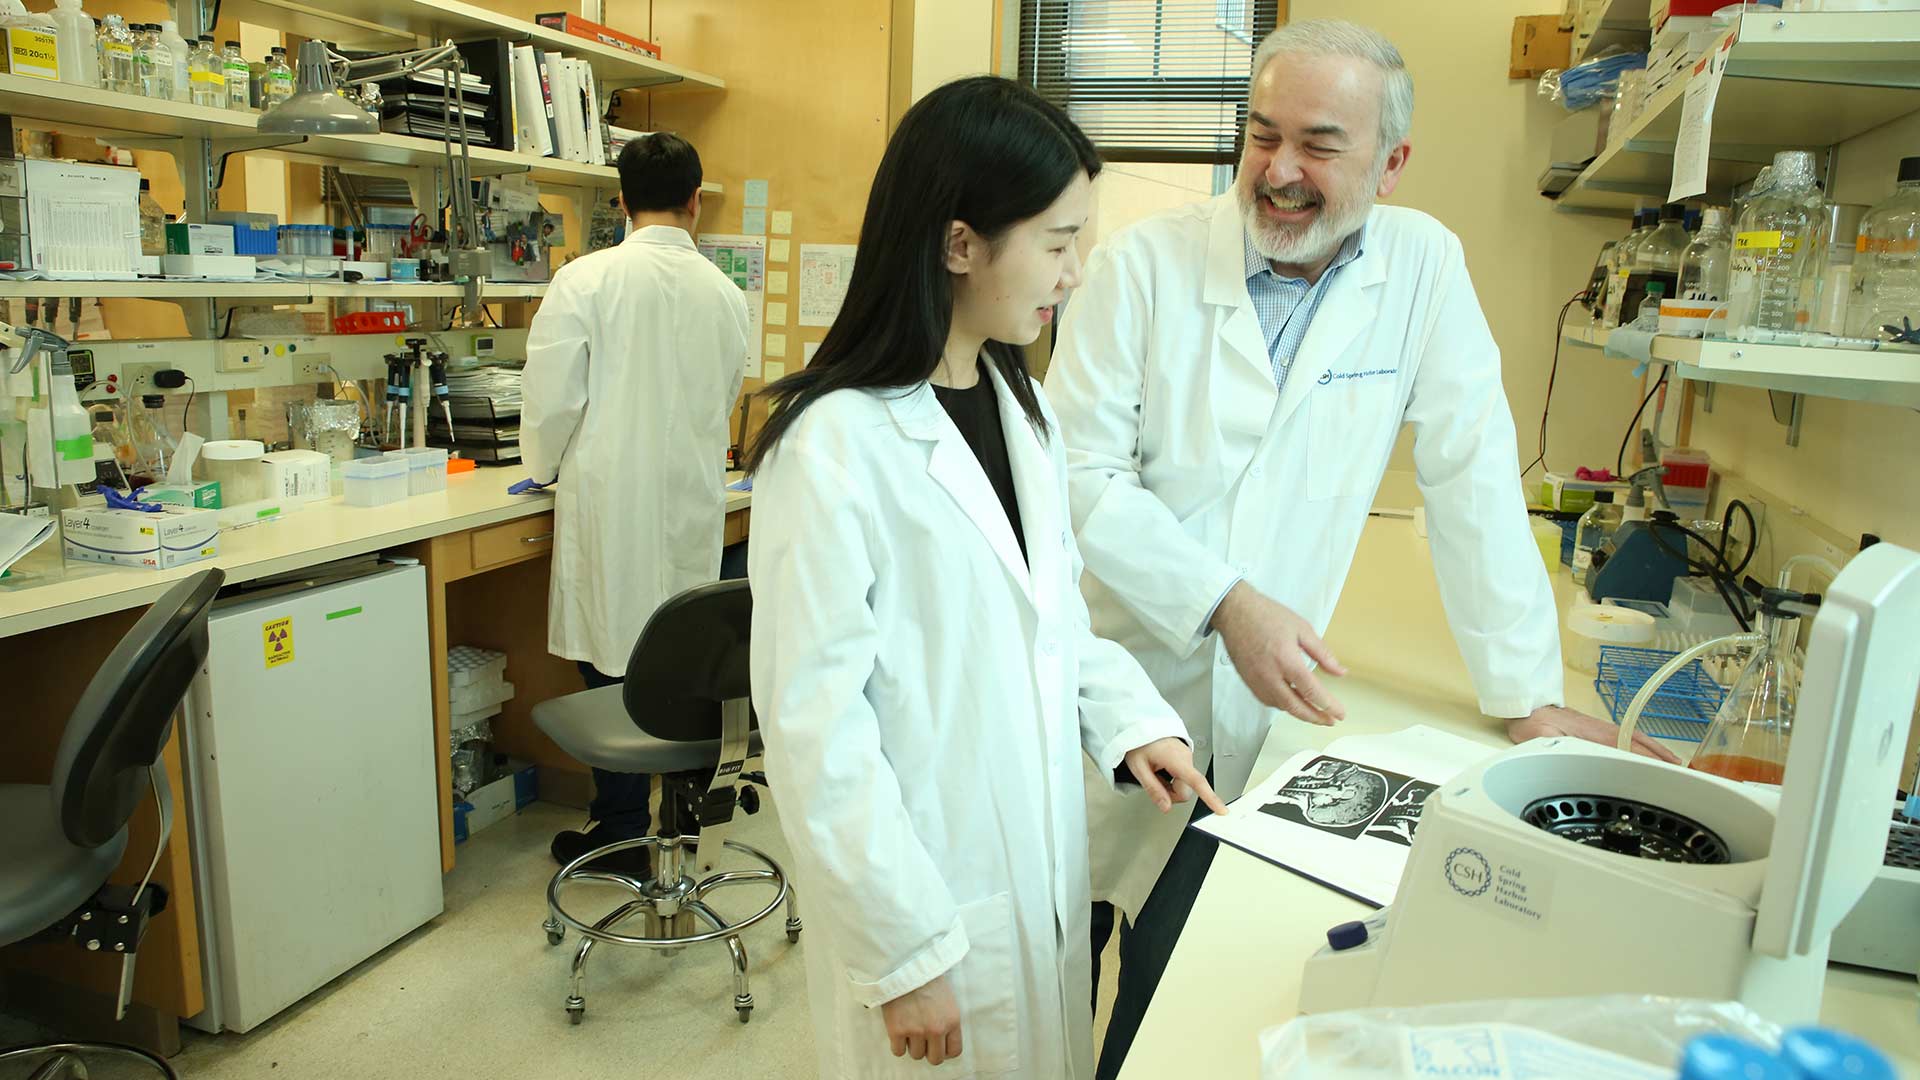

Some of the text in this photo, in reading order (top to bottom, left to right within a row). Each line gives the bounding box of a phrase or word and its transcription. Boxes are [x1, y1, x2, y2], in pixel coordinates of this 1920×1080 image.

[143, 558, 157, 566] USA
[1454, 863, 1482, 883] CSH
[1500, 865, 1520, 878] Cold
[1499, 875, 1526, 893] Spring
[1496, 886, 1527, 902] Harbor
[1494, 896, 1541, 920] Laboratory
